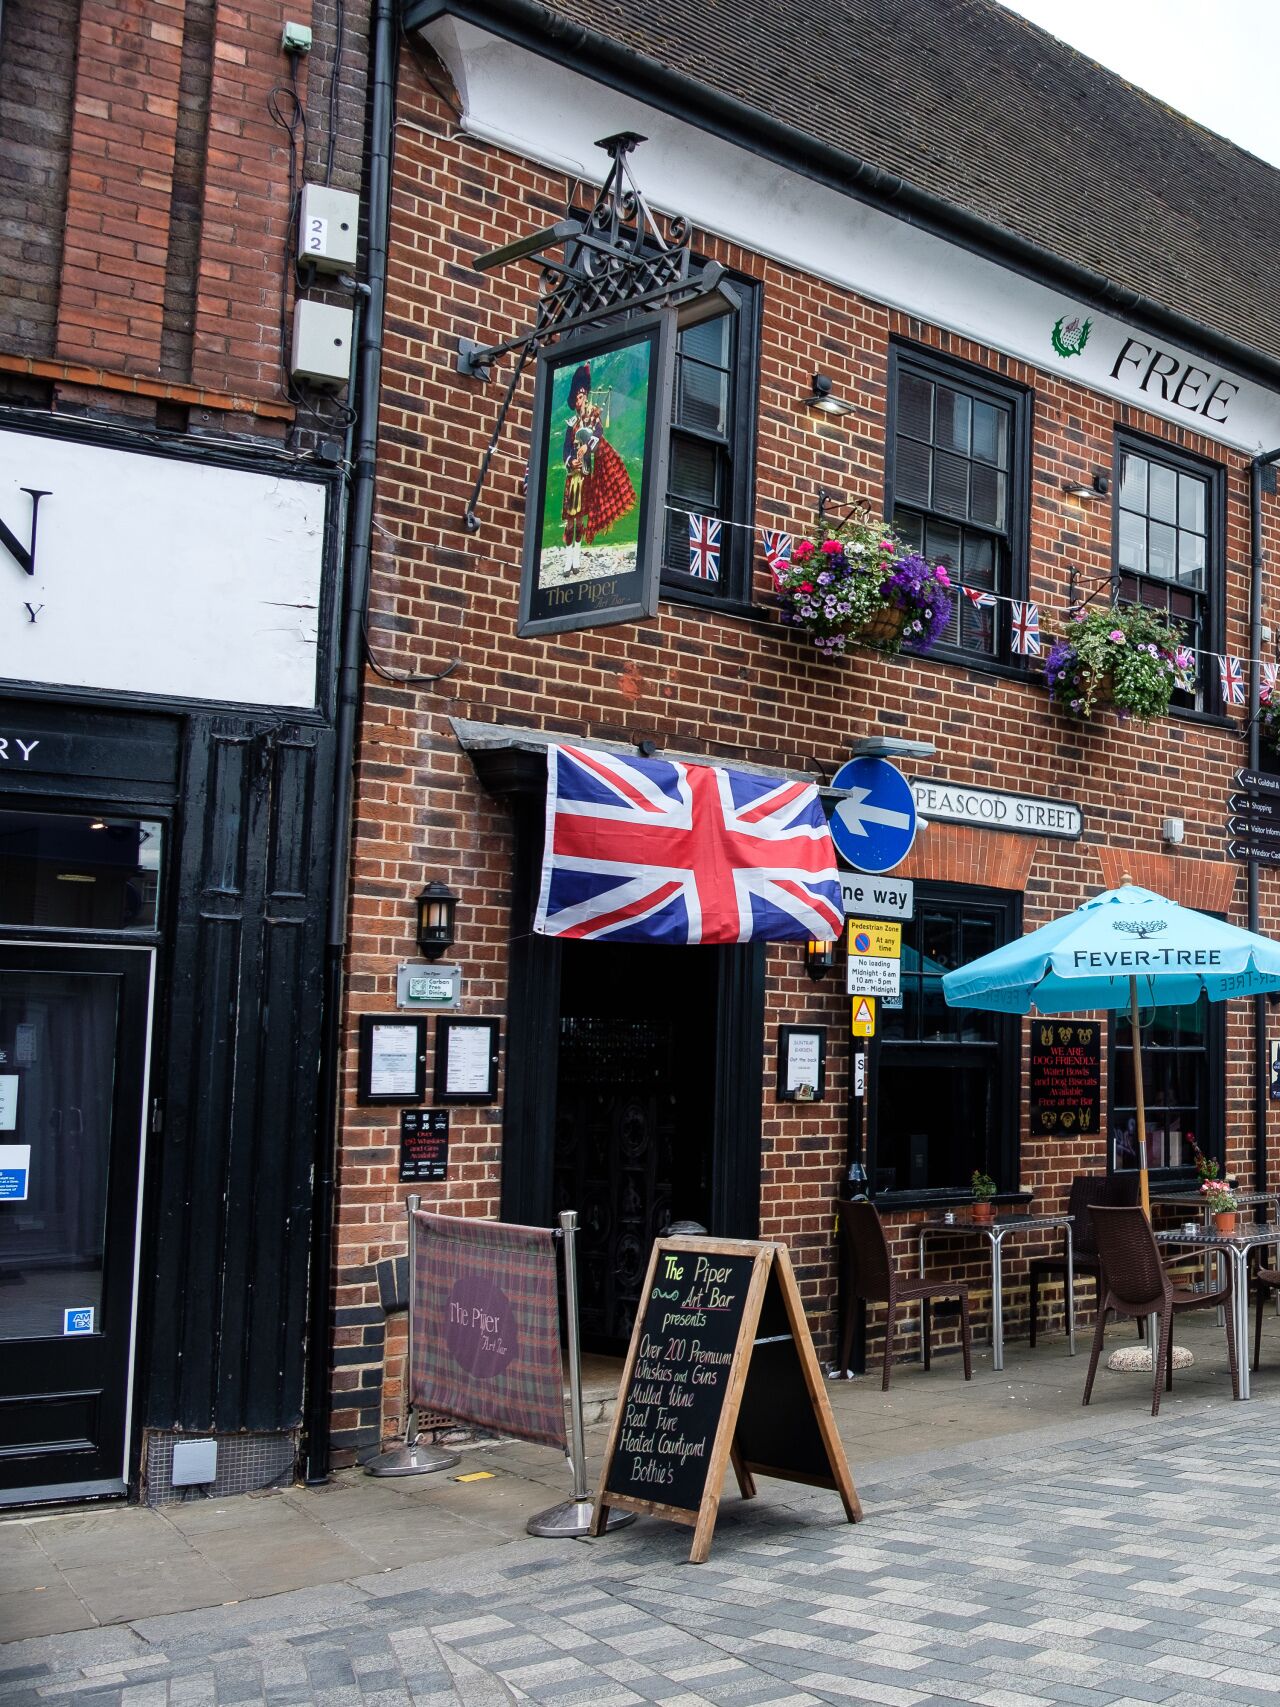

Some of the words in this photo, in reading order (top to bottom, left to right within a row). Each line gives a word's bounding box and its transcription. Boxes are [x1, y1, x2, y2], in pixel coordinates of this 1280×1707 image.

[1109, 337, 1240, 424] FREE
[546, 587, 575, 606] The
[578, 580, 618, 603] Piper
[916, 787, 1007, 820] PEASCOD
[1015, 803, 1076, 830] STREET
[1252, 803, 1273, 814] Shopping
[1251, 825, 1265, 834] Visitor
[1251, 848, 1270, 857] Windsor
[874, 889, 908, 908] way
[852, 922, 883, 931] Pedestrian
[869, 960, 890, 968] loading
[1074, 948, 1221, 968] FEVER-TREE
[852, 968, 878, 977] Midnight
[871, 986, 896, 994] Midnight
[1051, 1047, 1065, 1056] WE
[1067, 1047, 1084, 1056] ARE
[858, 1059, 865, 1070] S
[1033, 1056, 1053, 1065] DOG
[1043, 1067, 1064, 1076] Water
[1066, 1067, 1089, 1076] Bowls
[857, 1078, 864, 1090] 2
[1034, 1077, 1049, 1086] and
[1051, 1077, 1067, 1088] Dog
[1069, 1077, 1097, 1087] Biscuits
[1050, 1086, 1083, 1096] Available
[1039, 1097, 1056, 1106] Free
[1057, 1098, 1065, 1106] at
[1067, 1097, 1079, 1106] the
[1080, 1097, 1093, 1106] Bar
[664, 1256, 683, 1281] The
[694, 1257, 733, 1293] Piper
[682, 1286, 704, 1308] Art
[708, 1287, 735, 1308] Bar
[450, 1302, 469, 1326] The
[661, 1311, 707, 1333] presents
[482, 1335, 496, 1352] Art
[639, 1334, 663, 1360] Over
[664, 1337, 687, 1362] 200
[688, 1339, 731, 1366] Premium
[634, 1359, 673, 1382] Whiskies
[674, 1370, 687, 1383] and
[691, 1364, 718, 1385] Gins
[628, 1384, 663, 1406] Mulled
[669, 1384, 695, 1408] Wine
[623, 1404, 650, 1428] Real
[655, 1407, 679, 1432] Fire
[619, 1429, 655, 1453] Heated
[658, 1433, 706, 1466] Courtyard
[630, 1457, 675, 1484] Bothie's
